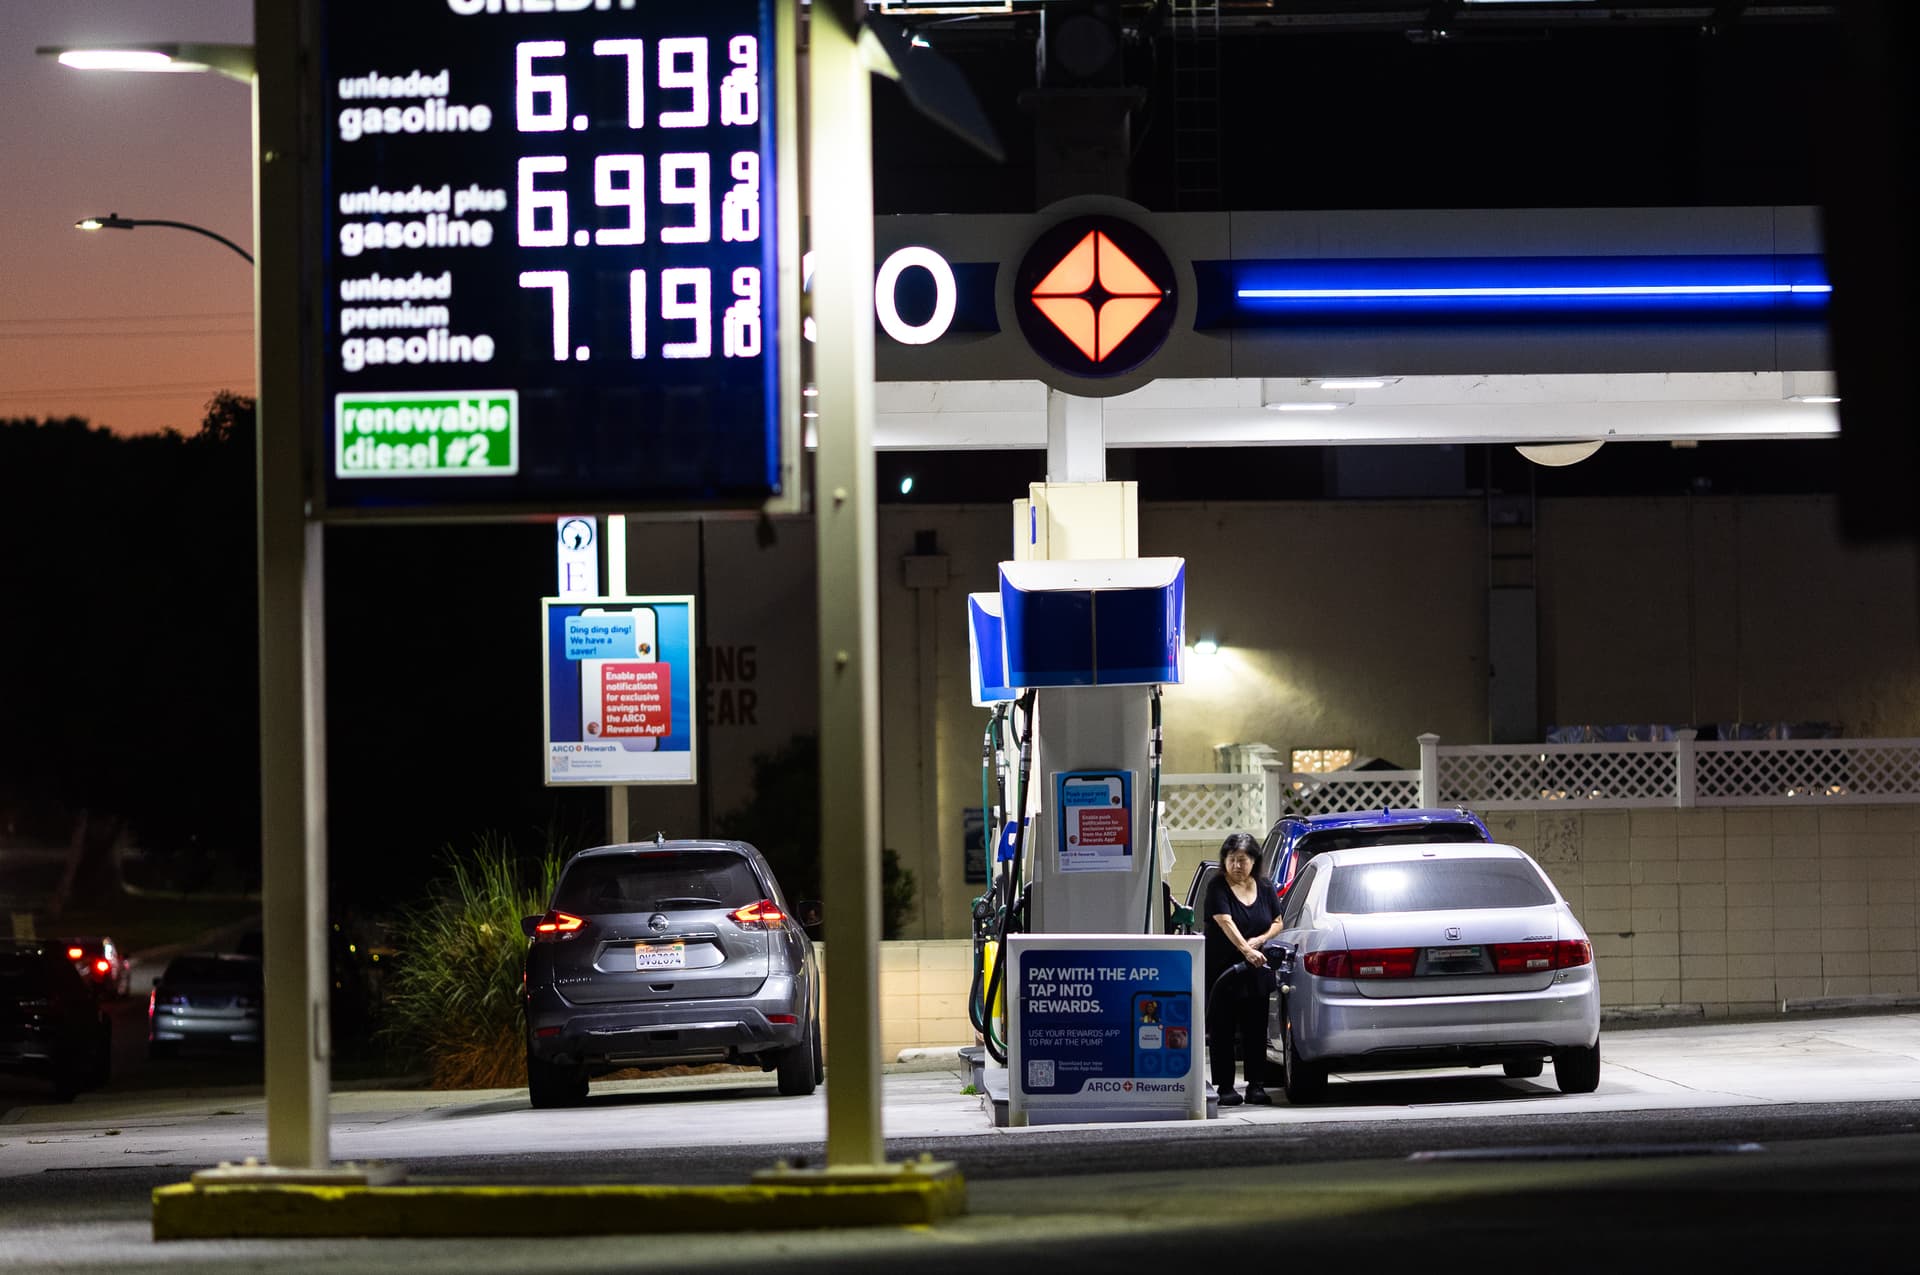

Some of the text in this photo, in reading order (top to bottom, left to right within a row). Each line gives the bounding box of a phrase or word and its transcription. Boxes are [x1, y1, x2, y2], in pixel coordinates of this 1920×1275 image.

[338, 69, 450, 99] unleaded
[338, 98, 492, 142] gasoline
[339, 183, 507, 217] unleaded plus
[339, 213, 493, 257] gasoline
[340, 271, 451, 301] unleaded
[340, 300, 450, 335] premium
[341, 329, 495, 373] gasoline
[343, 401, 508, 435] renewable
[343, 434, 490, 470] diesel #2
[570, 624, 631, 635] Ding ding ding!
[585, 636, 605, 644] have
[570, 647, 597, 655] saver!
[606, 671, 657, 681] Enable push
[606, 682, 657, 691] notifications
[606, 692, 660, 701] for exclusive
[606, 703, 661, 713] savings from
[606, 714, 646, 722] the ARCO
[606, 725, 665, 735] Rewards App!
[1029, 968, 1160, 981] PAY WITH THE APP.
[1029, 984, 1093, 997] TAP INTO
[1029, 1000, 1104, 1013] REWARDS.
[1066, 1029, 1103, 1037] REWARDS
[1105, 1029, 1120, 1037] APP
[1065, 1038, 1079, 1046] THE
[1087, 1082, 1185, 1092] ARCO Rewards
